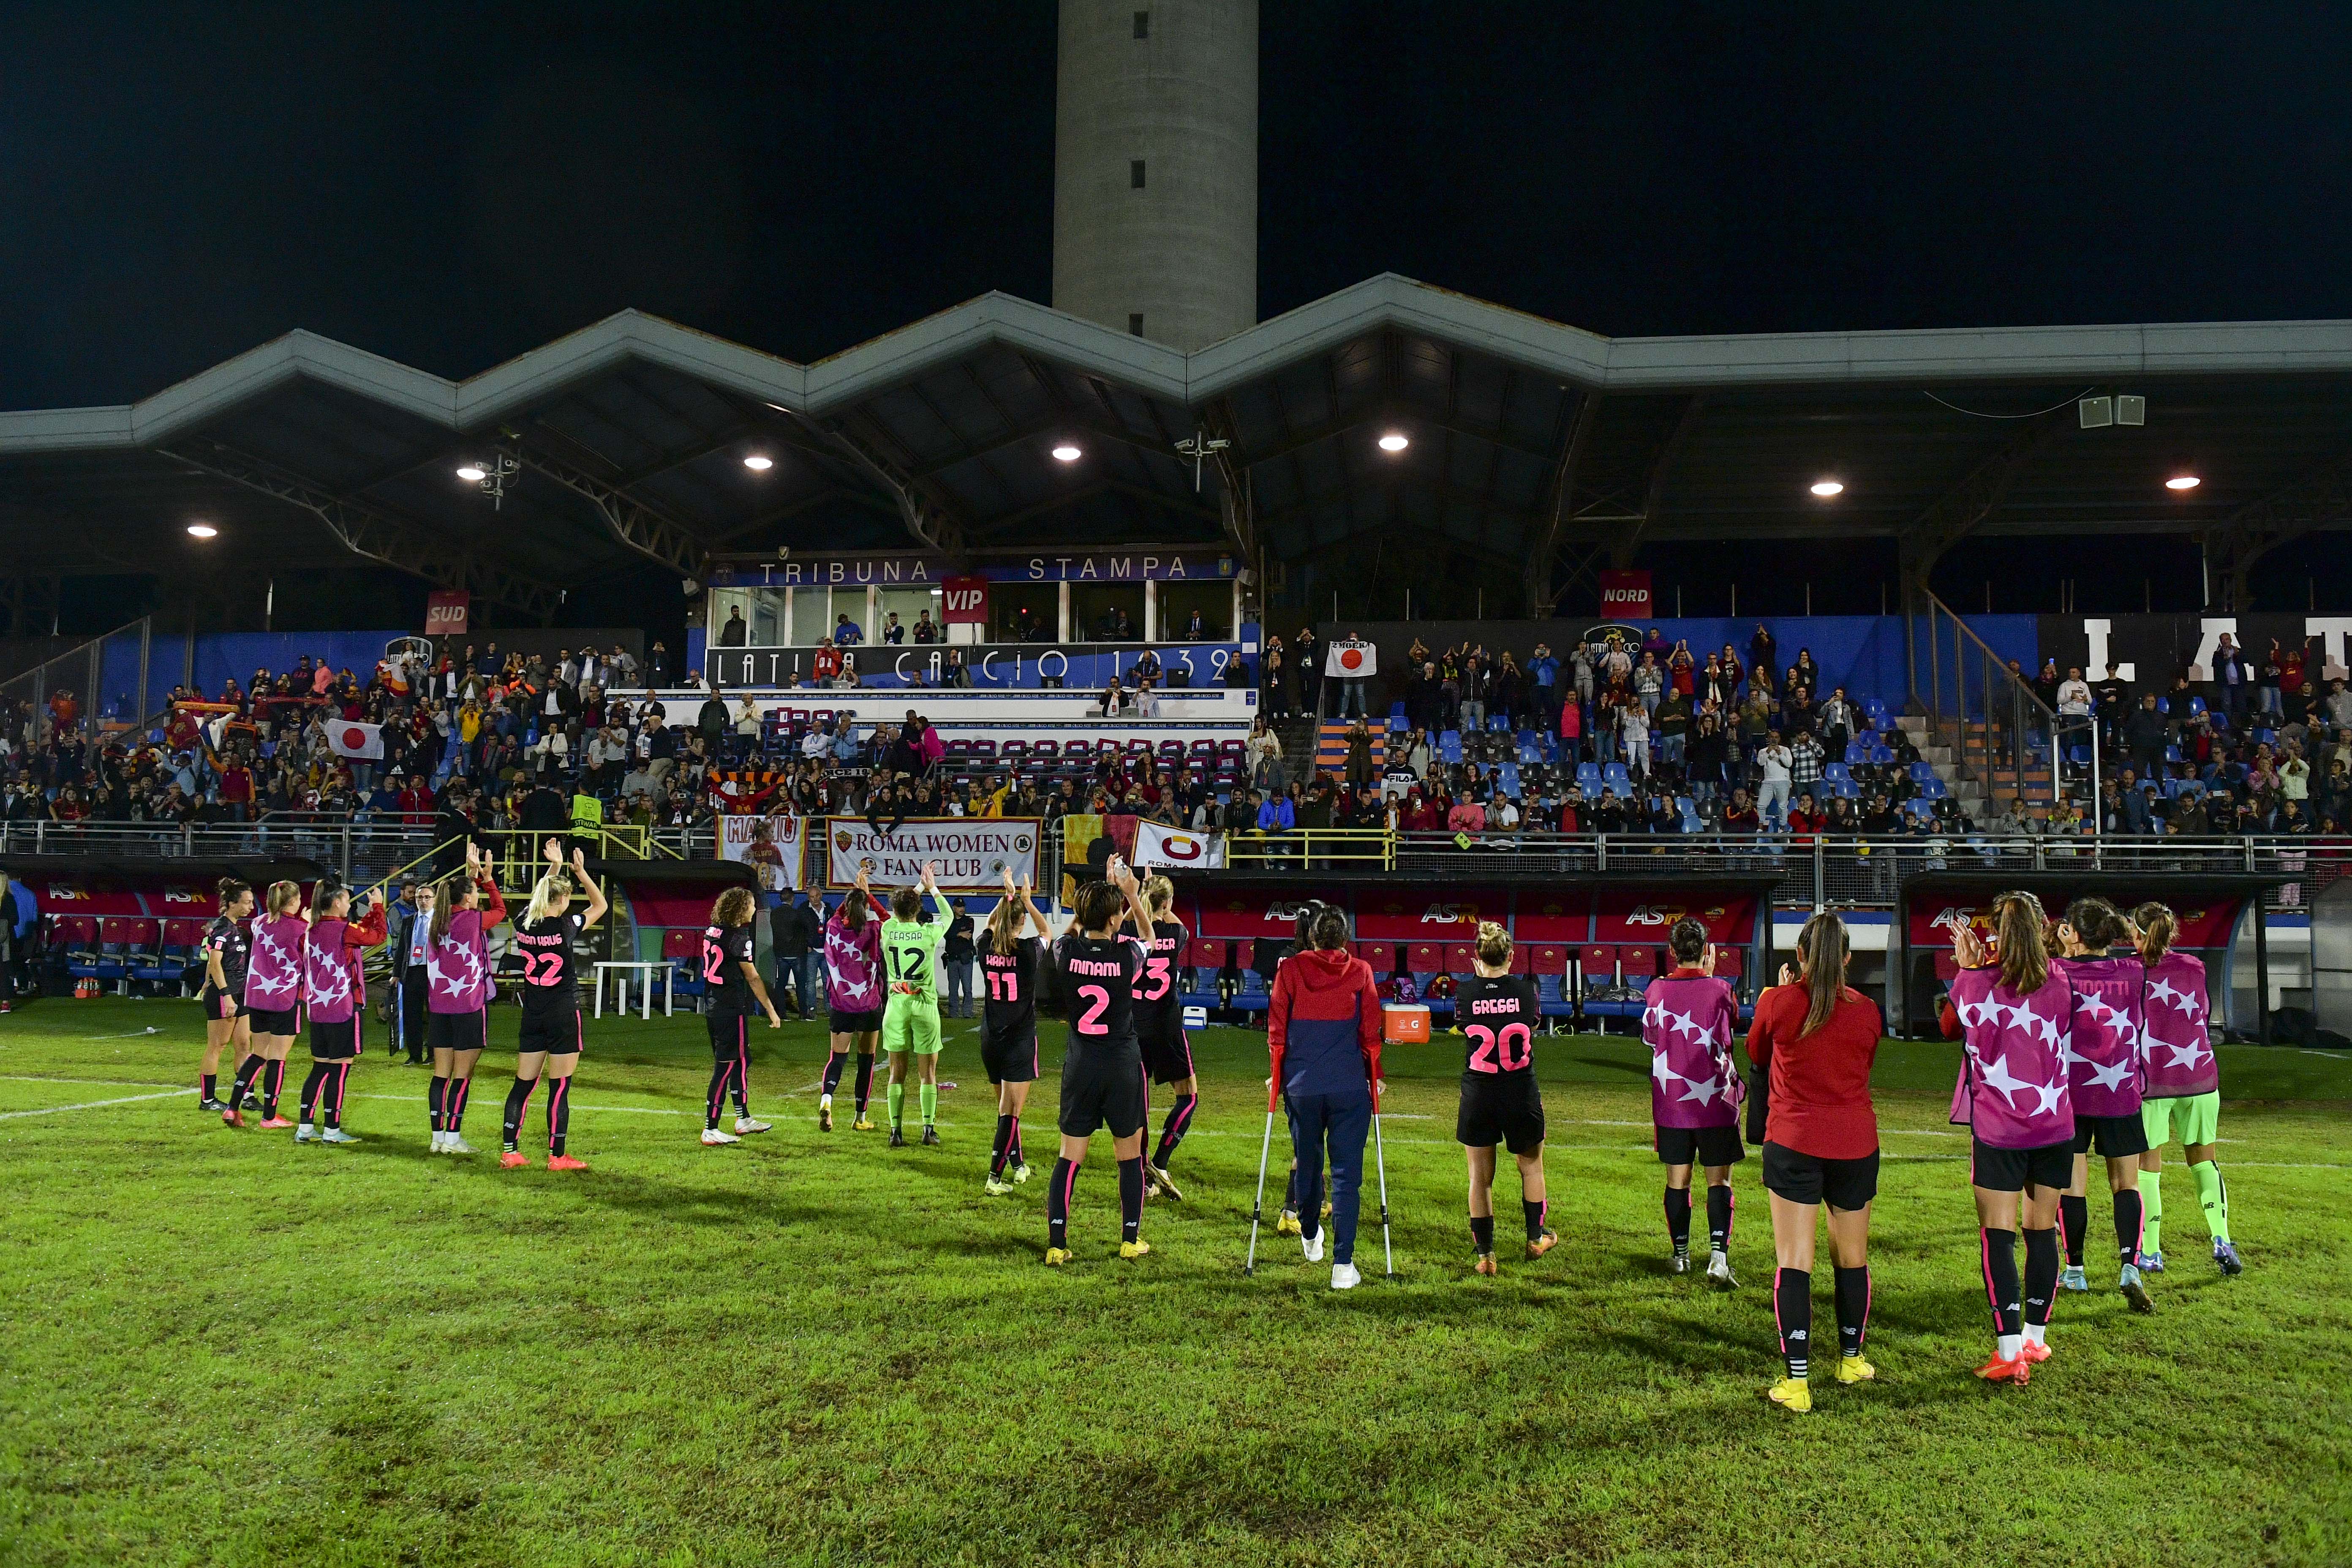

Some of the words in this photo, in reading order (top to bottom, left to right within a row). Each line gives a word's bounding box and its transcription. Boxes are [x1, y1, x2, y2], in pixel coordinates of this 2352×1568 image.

[760, 561, 928, 583] TRIBUNA
[1029, 556, 1186, 579] STAMPA
[946, 590, 983, 610] VIP
[1604, 589, 1648, 602] NORD
[430, 606, 465, 622] SUD
[718, 652, 854, 683] LATIA
[574, 819, 598, 829] STEWAR
[856, 834, 920, 854] ROMA
[926, 835, 1010, 855] WOMEN
[884, 859, 923, 879] FAN
[929, 860, 981, 879] CLUB
[1148, 860, 1179, 870] ROMA
[48, 882, 90, 901] ASR
[164, 885, 207, 905] ASR
[1264, 901, 1304, 920] AS
[1421, 904, 1479, 923] ASR
[1625, 905, 1687, 925] ASR
[1929, 907, 1991, 928] ASR
[537, 933, 562, 946] HAUG
[889, 930, 922, 941] CEASAR
[519, 949, 563, 986] 22
[888, 946, 925, 981] 12
[986, 954, 1017, 967] HAAVI
[1069, 958, 1121, 977] MINAMI
[987, 971, 1017, 1002] 11
[1077, 985, 1110, 1034] 2
[1472, 998, 1520, 1015] GREGGI
[1411, 1020, 1419, 1029] G
[1465, 1022, 1531, 1073] 20
